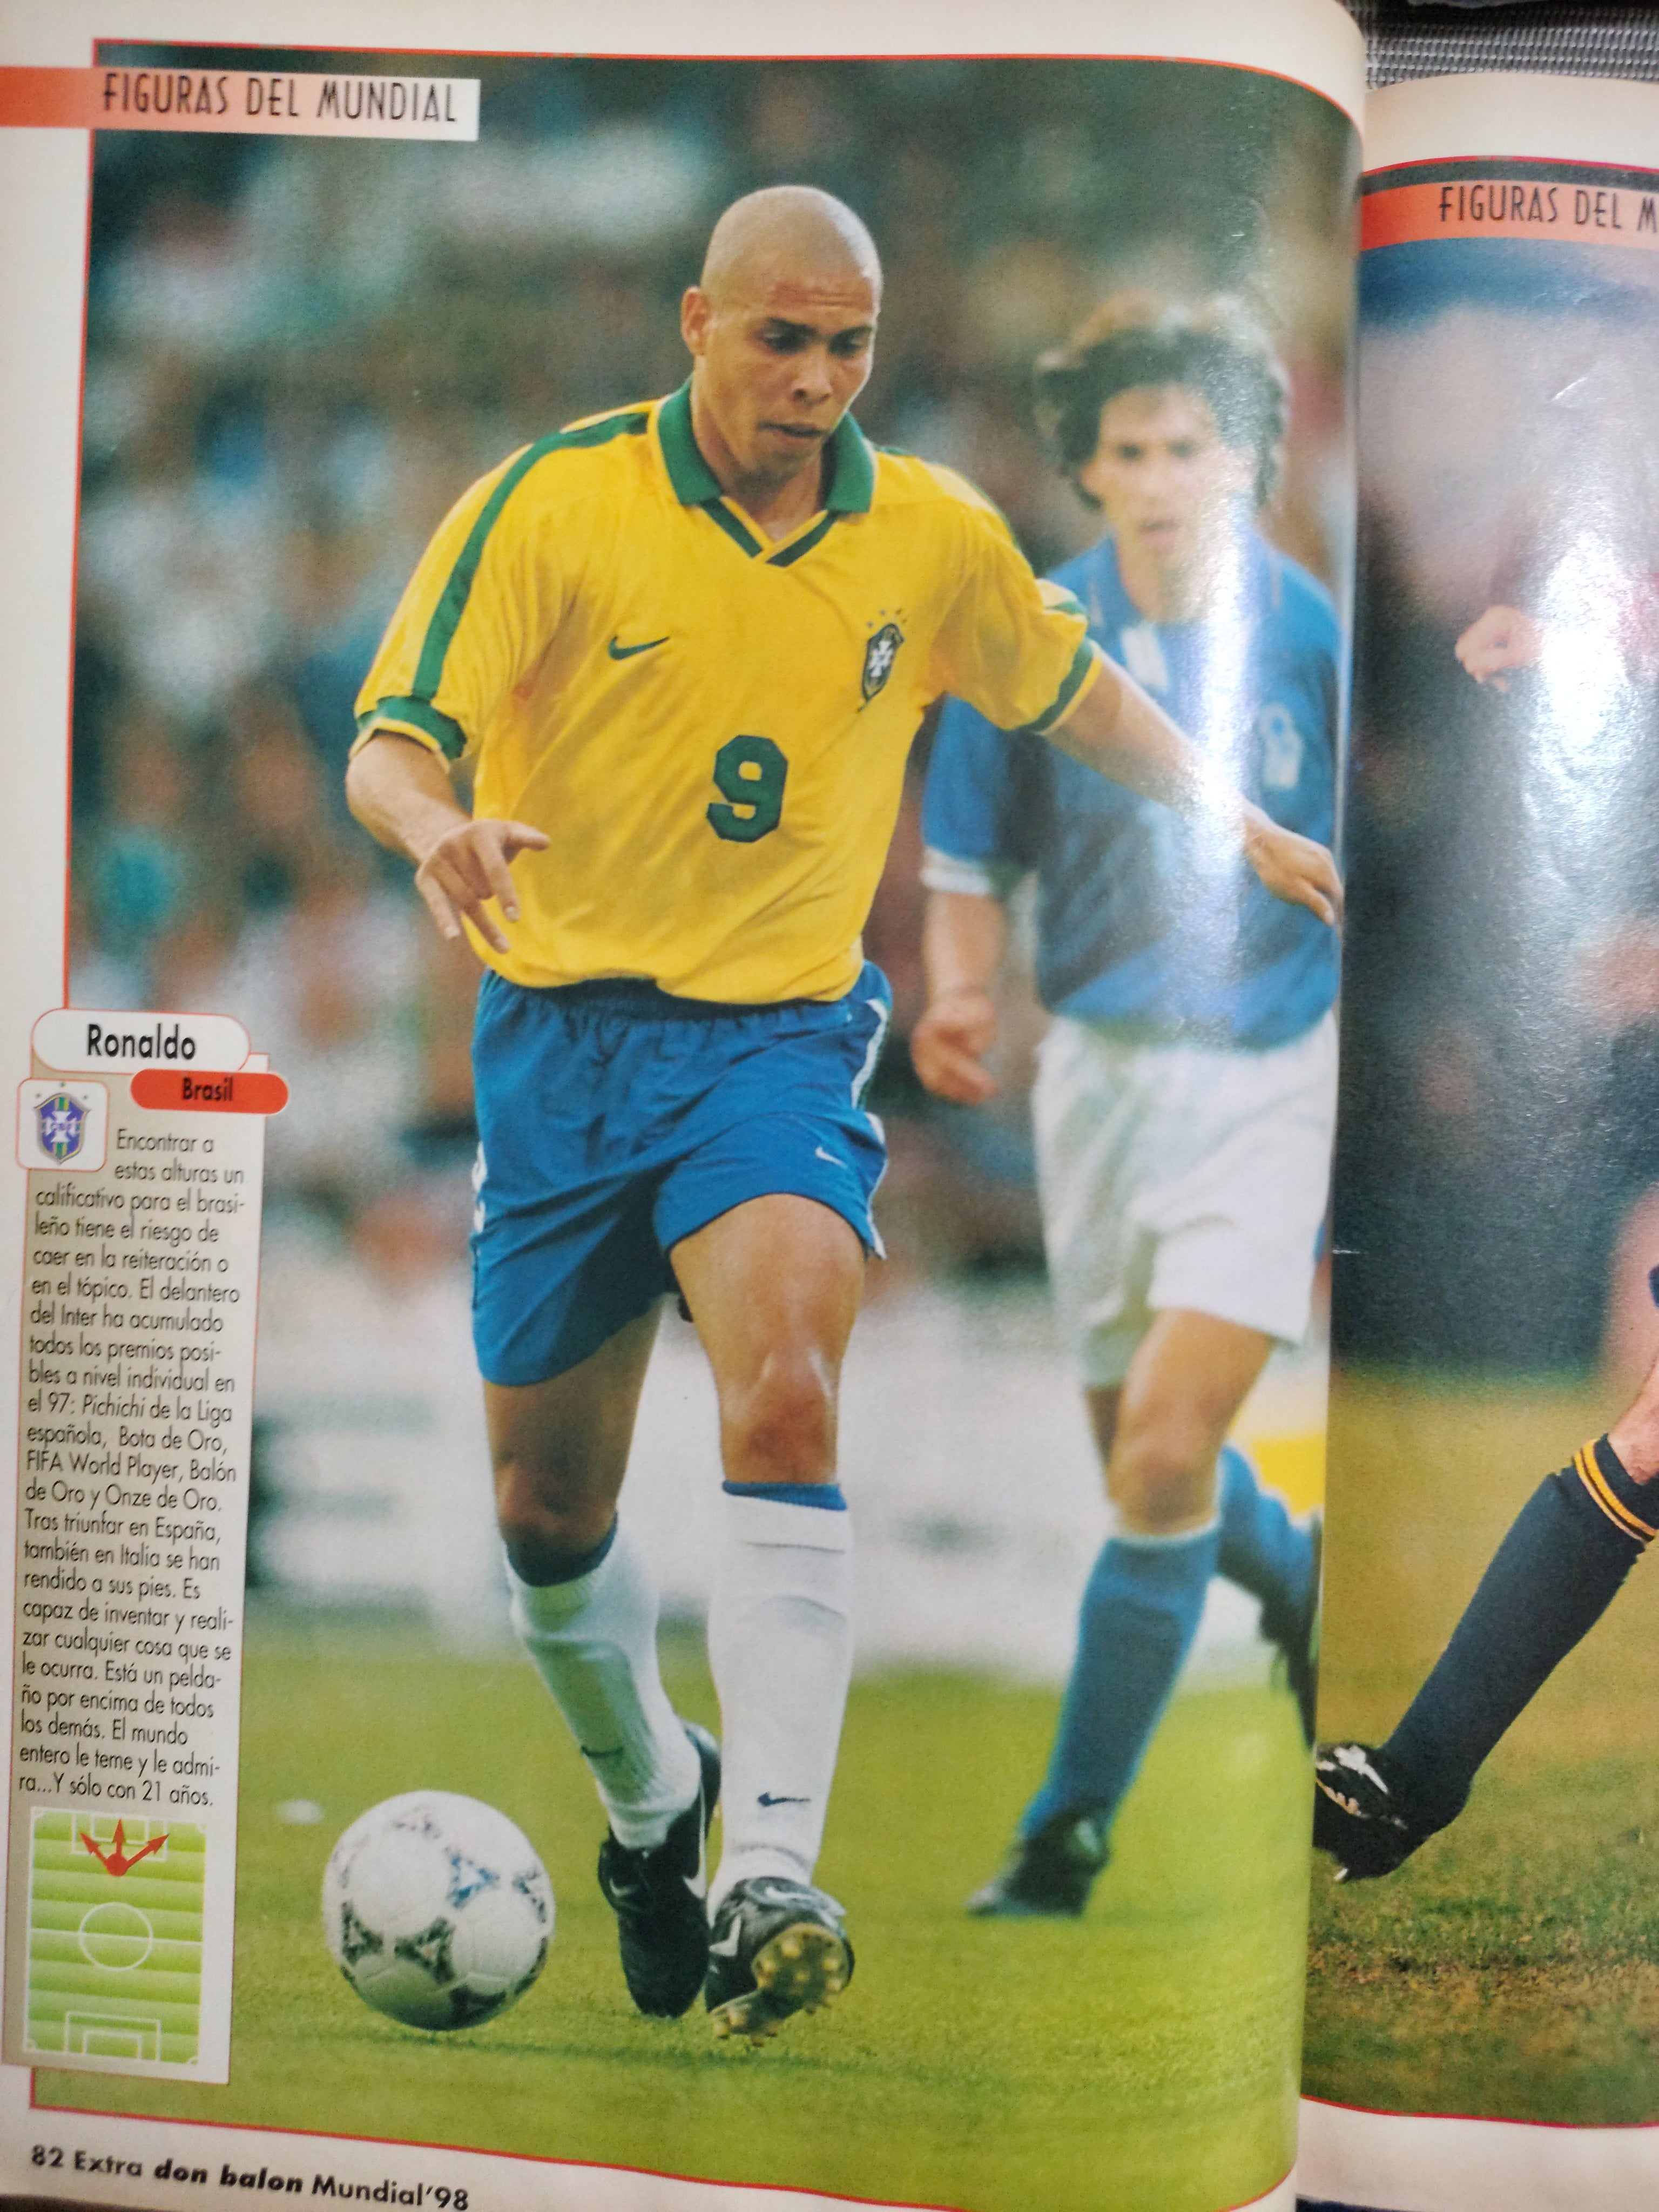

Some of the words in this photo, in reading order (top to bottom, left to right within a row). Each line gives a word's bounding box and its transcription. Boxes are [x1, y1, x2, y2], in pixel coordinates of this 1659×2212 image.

[104, 72, 229, 115] FIGURAS
[246, 77, 300, 117] DEL
[316, 79, 458, 122] MUNDIAL
[1439, 185, 1558, 222] FIGURAS
[1575, 189, 1622, 229] DEL
[1638, 197, 1658, 233] M
[706, 734, 788, 843] 9
[87, 1023, 196, 1060] Ronaldo
[181, 1076, 233, 1101] Brasil
[116, 1129, 197, 1153] Encontrar
[202, 1138, 214, 1153] a
[114, 1162, 156, 1181] estas
[161, 1157, 218, 1183] alturas
[224, 1169, 244, 1184] un
[36, 1182, 125, 1209] calificativo
[130, 1192, 171, 1219] para
[177, 1188, 191, 1212] el
[197, 1191, 245, 1214] brasi-
[35, 1211, 69, 1237] leño
[75, 1215, 115, 1239] tiene
[120, 1212, 134, 1239] el
[140, 1220, 192, 1247] riesgo
[198, 1219, 219, 1243] de
[32, 1250, 69, 1267] caer
[75, 1253, 95, 1268] en
[101, 1244, 116, 1269] la
[122, 1247, 212, 1273] reiteración
[217, 1257, 228, 1273] o
[31, 1278, 51, 1294] en
[57, 1272, 72, 1296] el
[77, 1276, 132, 1304] tópico.
[139, 1278, 153, 1300] El
[160, 1276, 240, 1304] delantero
[30, 1300, 55, 1324] del
[61, 1305, 97, 1326] Inter
[102, 1305, 123, 1327] ha
[129, 1307, 224, 1333] acumulado
[29, 1330, 73, 1354] todos
[79, 1332, 102, 1357] los
[108, 1337, 174, 1365] premios
[180, 1343, 221, 1370] posi-
[29, 1359, 60, 1385] bles
[67, 1370, 77, 1385] a
[82, 1361, 121, 1388] nivel
[127, 1366, 209, 1391] individual
[215, 1376, 235, 1392] en
[28, 1390, 43, 1413] el
[48, 1392, 75, 1415] 97:
[82, 1393, 145, 1419] Pichichi
[150, 1395, 171, 1419] de
[176, 1397, 191, 1420] la
[197, 1399, 233, 1427] Liga
[27, 1423, 107, 1451] española,
[119, 1427, 155, 1449] Bota
[161, 1426, 183, 1450] de
[187, 1428, 228, 1453] Oro,
[26, 1449, 63, 1472] FIFA
[69, 1450, 122, 1478] World
[127, 1455, 184, 1485] Player,
[189, 1460, 237, 1483] Balón
[25, 1476, 47, 1501] de
[51, 1479, 85, 1504] Oro
[90, 1489, 100, 1510] y
[105, 1483, 151, 1508] Onze
[157, 1484, 178, 1509] de
[183, 1487, 221, 1512] Oro.
[25, 1508, 59, 1530] Tras
[64, 1510, 123, 1535] triunfar
[129, 1520, 149, 1537] en
[154, 1516, 220, 1546] España,
[24, 1537, 89, 1563] también
[95, 1548, 114, 1564] en
[120, 1545, 160, 1567] Italia
[166, 1553, 184, 1568] se
[189, 1548, 220, 1572] han
[24, 1567, 87, 1593] rendido
[92, 1579, 103, 1593] a
[108, 1580, 133, 1596] sus
[139, 1578, 176, 1606] pies.
[184, 1579, 200, 1600] Es
[23, 1601, 73, 1628] capaz
[78, 1596, 99, 1622] de
[104, 1600, 171, 1627] inventar
[175, 1612, 185, 1634] y
[190, 1604, 234, 1631] reali-
[23, 1630, 51, 1648] zar
[55, 1627, 131, 1657] cualquier
[135, 1638, 172, 1656] cosa
[178, 1642, 209, 1665] que
[214, 1645, 232, 1661] se
[22, 1651, 36, 1675] le
[41, 1661, 98, 1681] ocurra.
[105, 1660, 138, 1683] Está
[143, 1668, 163, 1684] un
[168, 1665, 221, 1695] pelda-
[21, 1683, 42, 1705] ño
[47, 1689, 76, 1714] por
[80, 1688, 138, 1712] encima
[144, 1688, 165, 1715] de
[170, 1694, 214, 1718] todos
[20, 1709, 43, 1734] los
[48, 1710, 105, 1739] demás.
[112, 1718, 126, 1740] El
[131, 1719, 188, 1745] mundo
[19, 1743, 70, 1765] entero
[75, 1741, 90, 1766] le
[95, 1750, 132, 1770] teme
[138, 1756, 149, 1778] y
[153, 1747, 167, 1773] le
[172, 1751, 220, 1777] admi-
[69, 1773, 102, 1798] sólo
[107, 1783, 136, 1800] con
[141, 1778, 161, 1802] 21
[169, 1781, 213, 1807] años.
[31, 2144, 64, 2168] 82
[73, 2149, 143, 2178] Extra
[154, 2157, 208, 2184] don
[220, 2163, 304, 2194] balon
